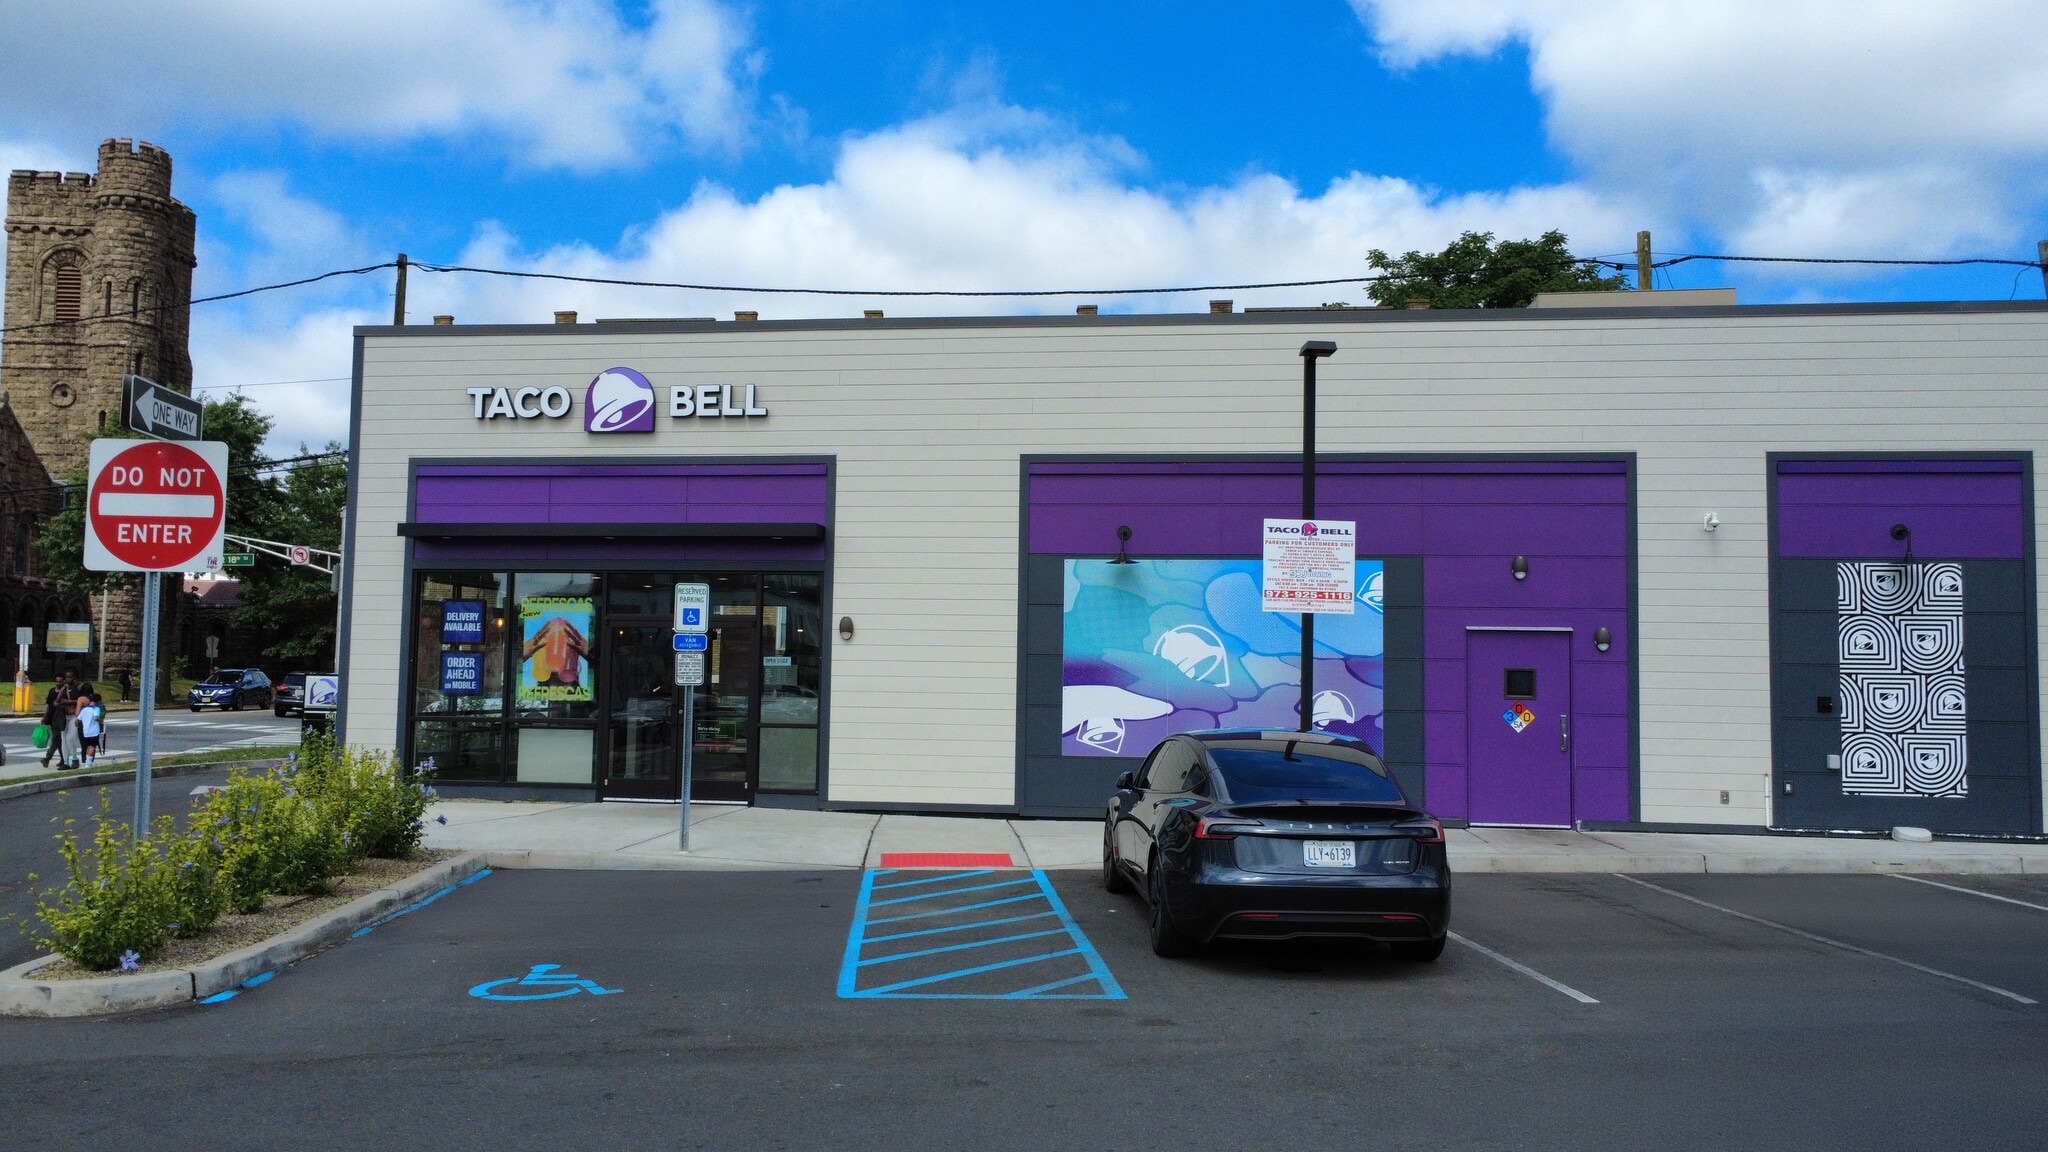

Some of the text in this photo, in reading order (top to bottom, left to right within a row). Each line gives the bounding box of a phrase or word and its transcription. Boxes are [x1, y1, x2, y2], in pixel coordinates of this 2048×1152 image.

[467, 384, 768, 419] TACO BELL
[152, 402, 195, 432] ONE WAY
[112, 466, 206, 488] DO NOT
[117, 524, 192, 544] ENTER
[1266, 590, 1351, 600] 973-925-1116
[522, 598, 593, 612] REFRESCAS
[446, 612, 479, 621] DELIVERY
[522, 610, 542, 618] NEW
[444, 622, 482, 632] AVAILABLE
[447, 658, 475, 668] ORDER
[446, 670, 475, 679] AHEAD
[519, 686, 590, 700] REFRESCAS
[1516, 704, 1522, 714] 0
[1506, 712, 1514, 722] 3
[1524, 712, 1530, 722] 0
